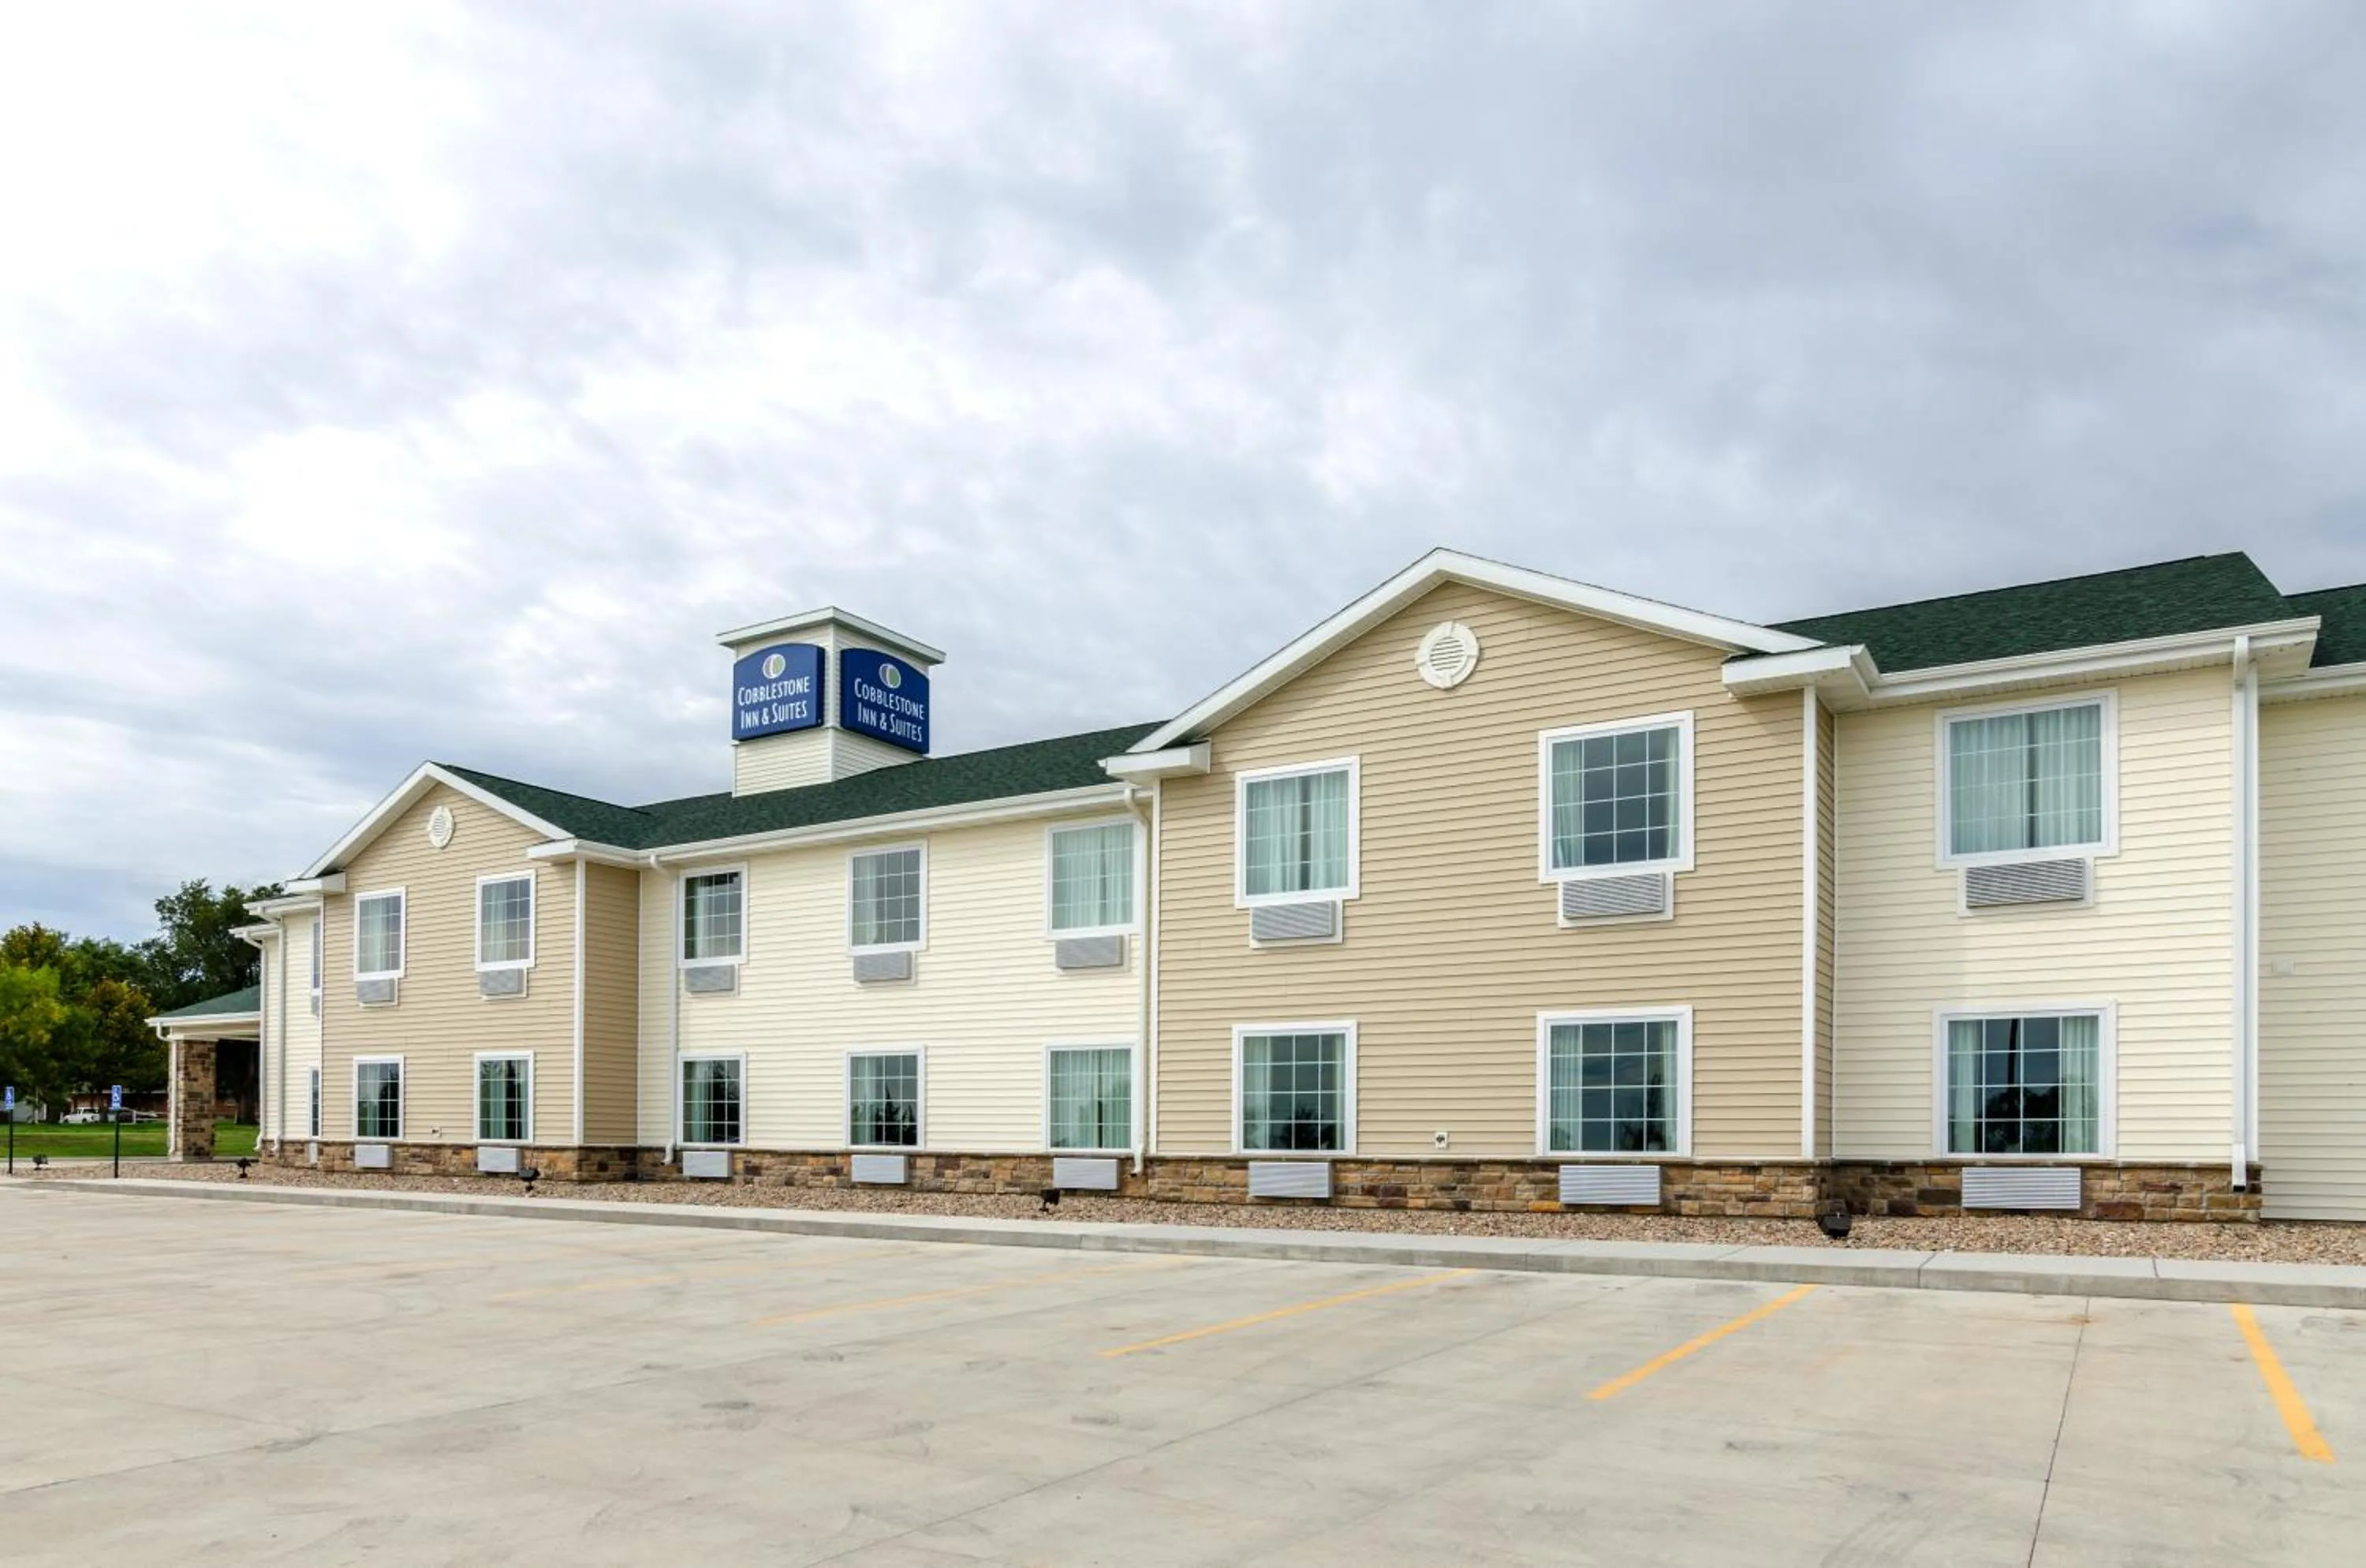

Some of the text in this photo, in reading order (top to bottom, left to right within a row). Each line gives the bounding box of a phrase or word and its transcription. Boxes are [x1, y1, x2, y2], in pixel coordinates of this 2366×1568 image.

[737, 676, 811, 706] COBBLESTONE
[854, 678, 924, 720] COBBLESTONE
[741, 700, 808, 729] INN & SUITES
[857, 702, 922, 742] INN & SUITES
